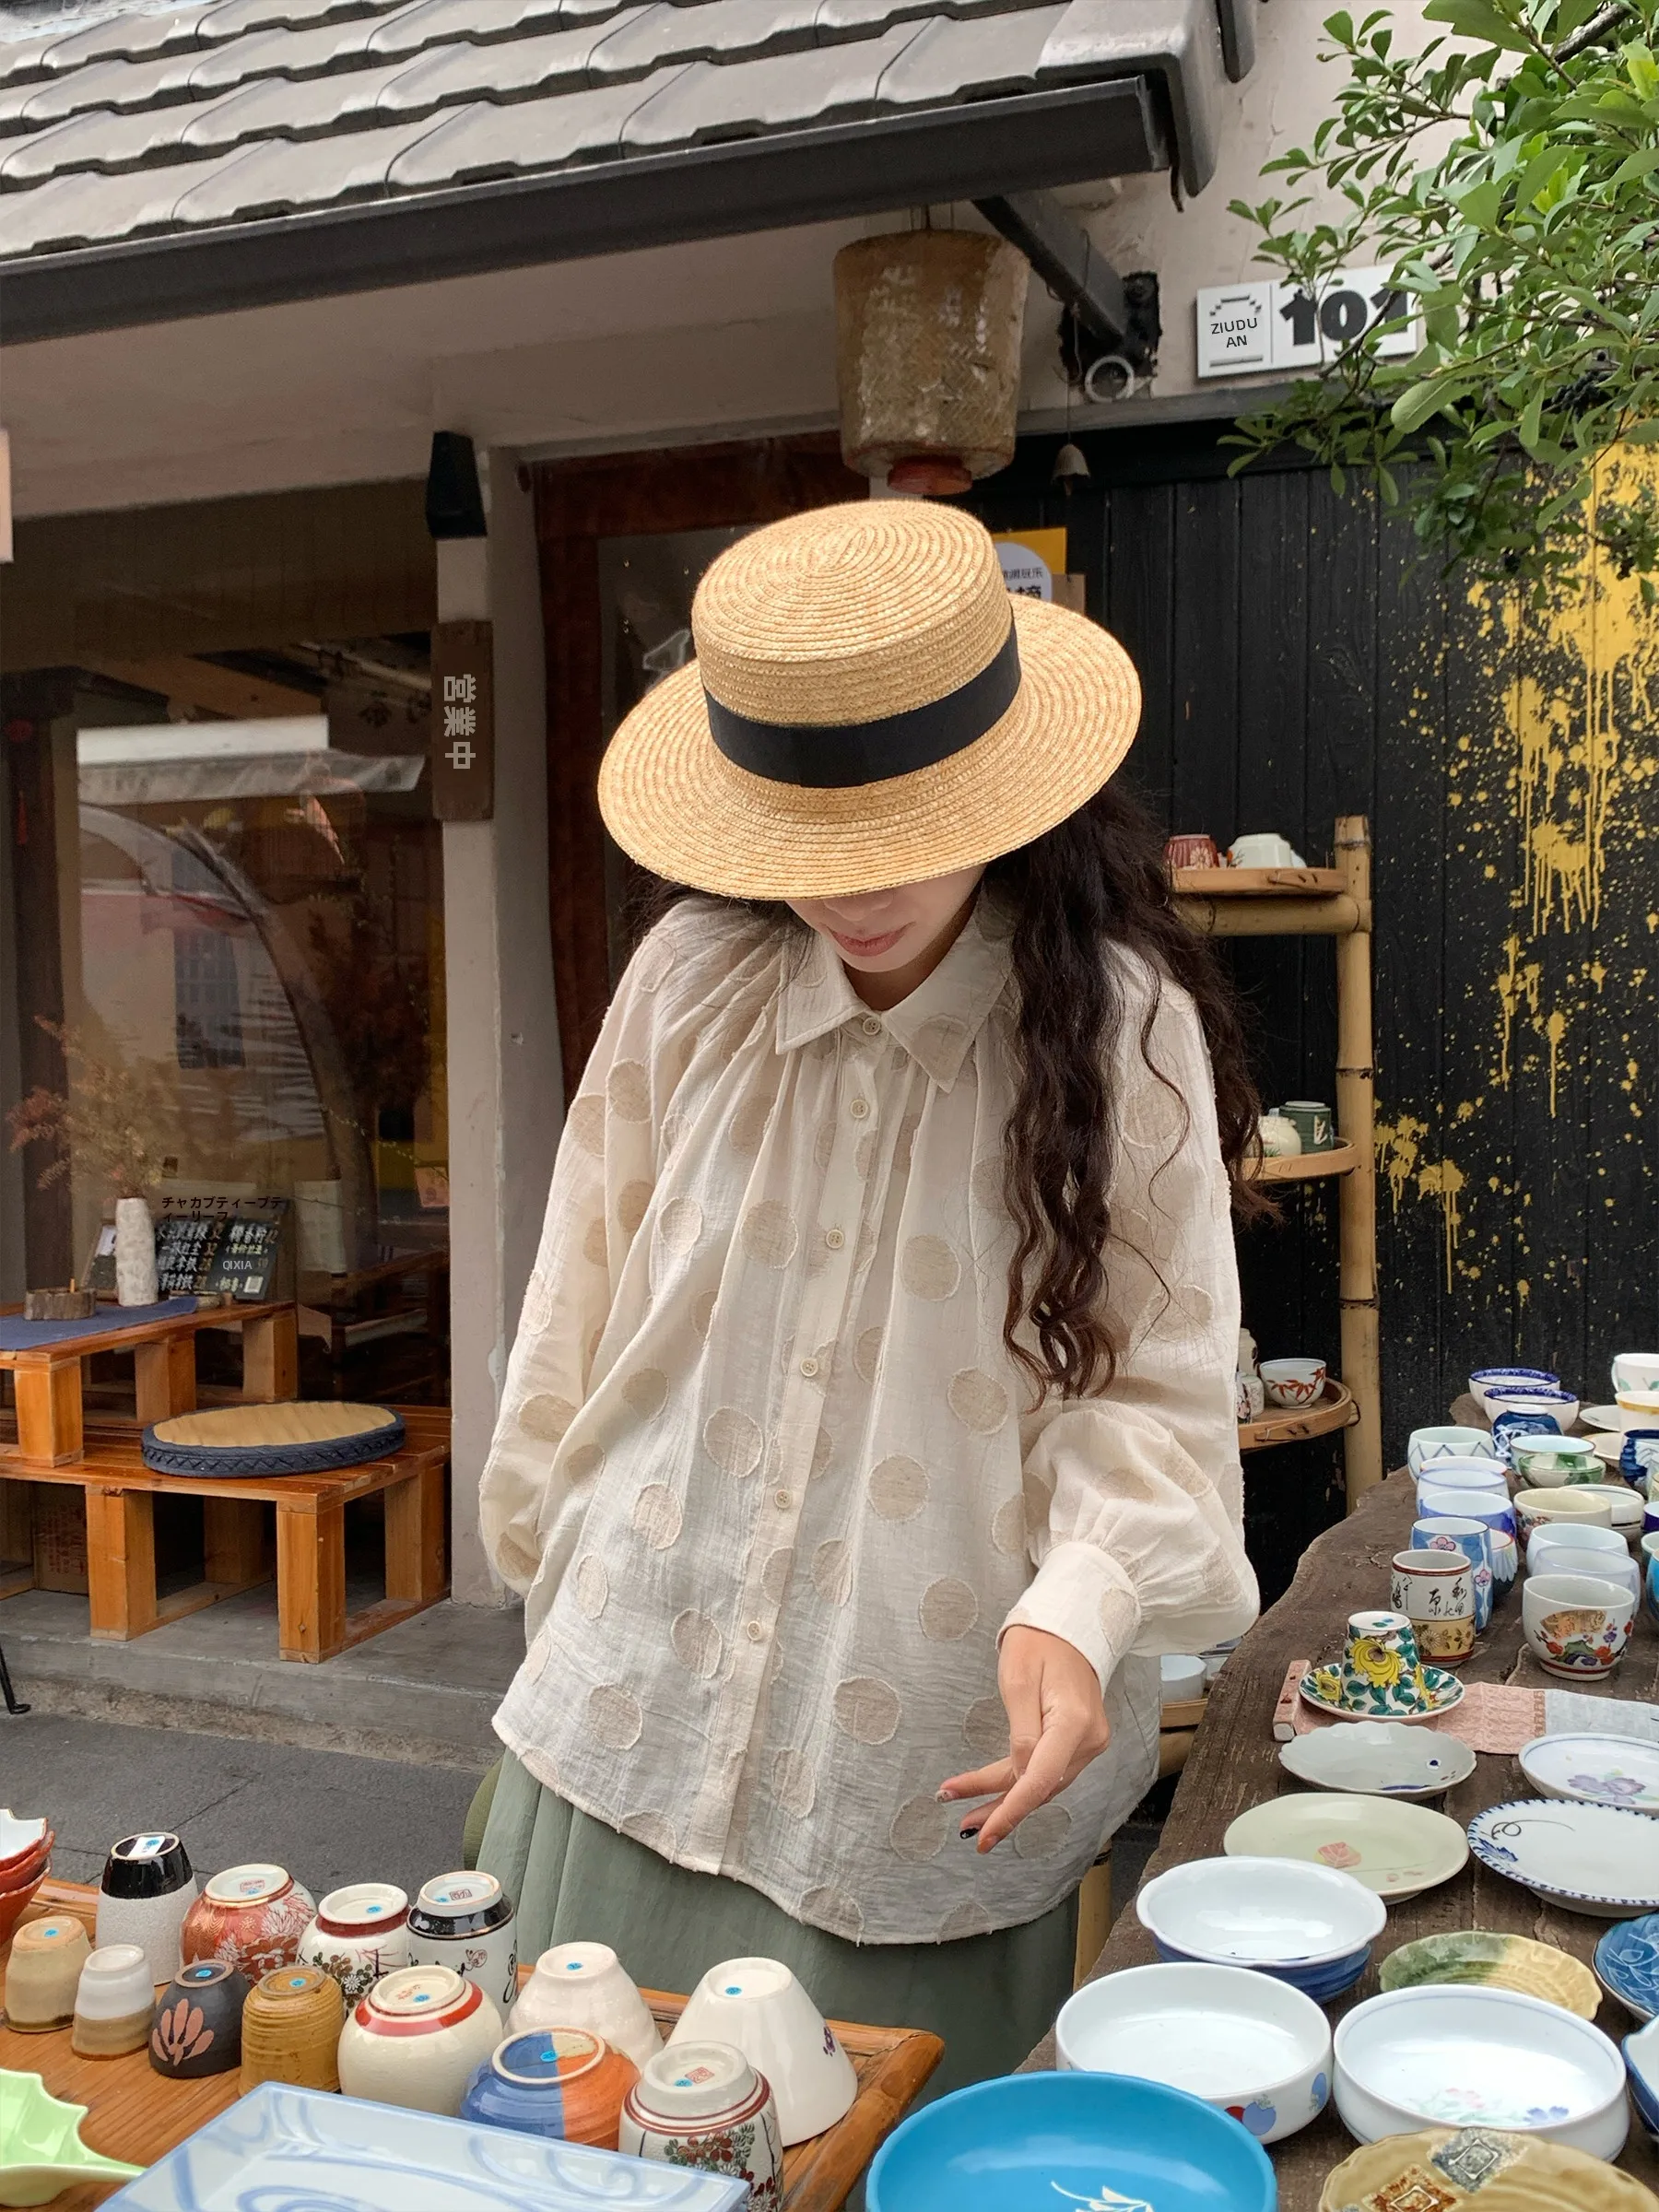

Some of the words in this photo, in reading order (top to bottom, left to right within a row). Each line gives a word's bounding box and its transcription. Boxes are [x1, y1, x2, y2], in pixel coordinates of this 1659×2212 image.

[1210, 317, 1258, 335] ZIUDU
[1226, 335, 1248, 348] AN
[443, 674, 477, 770] 営業中
[222, 1260, 253, 1271] QIXIA
